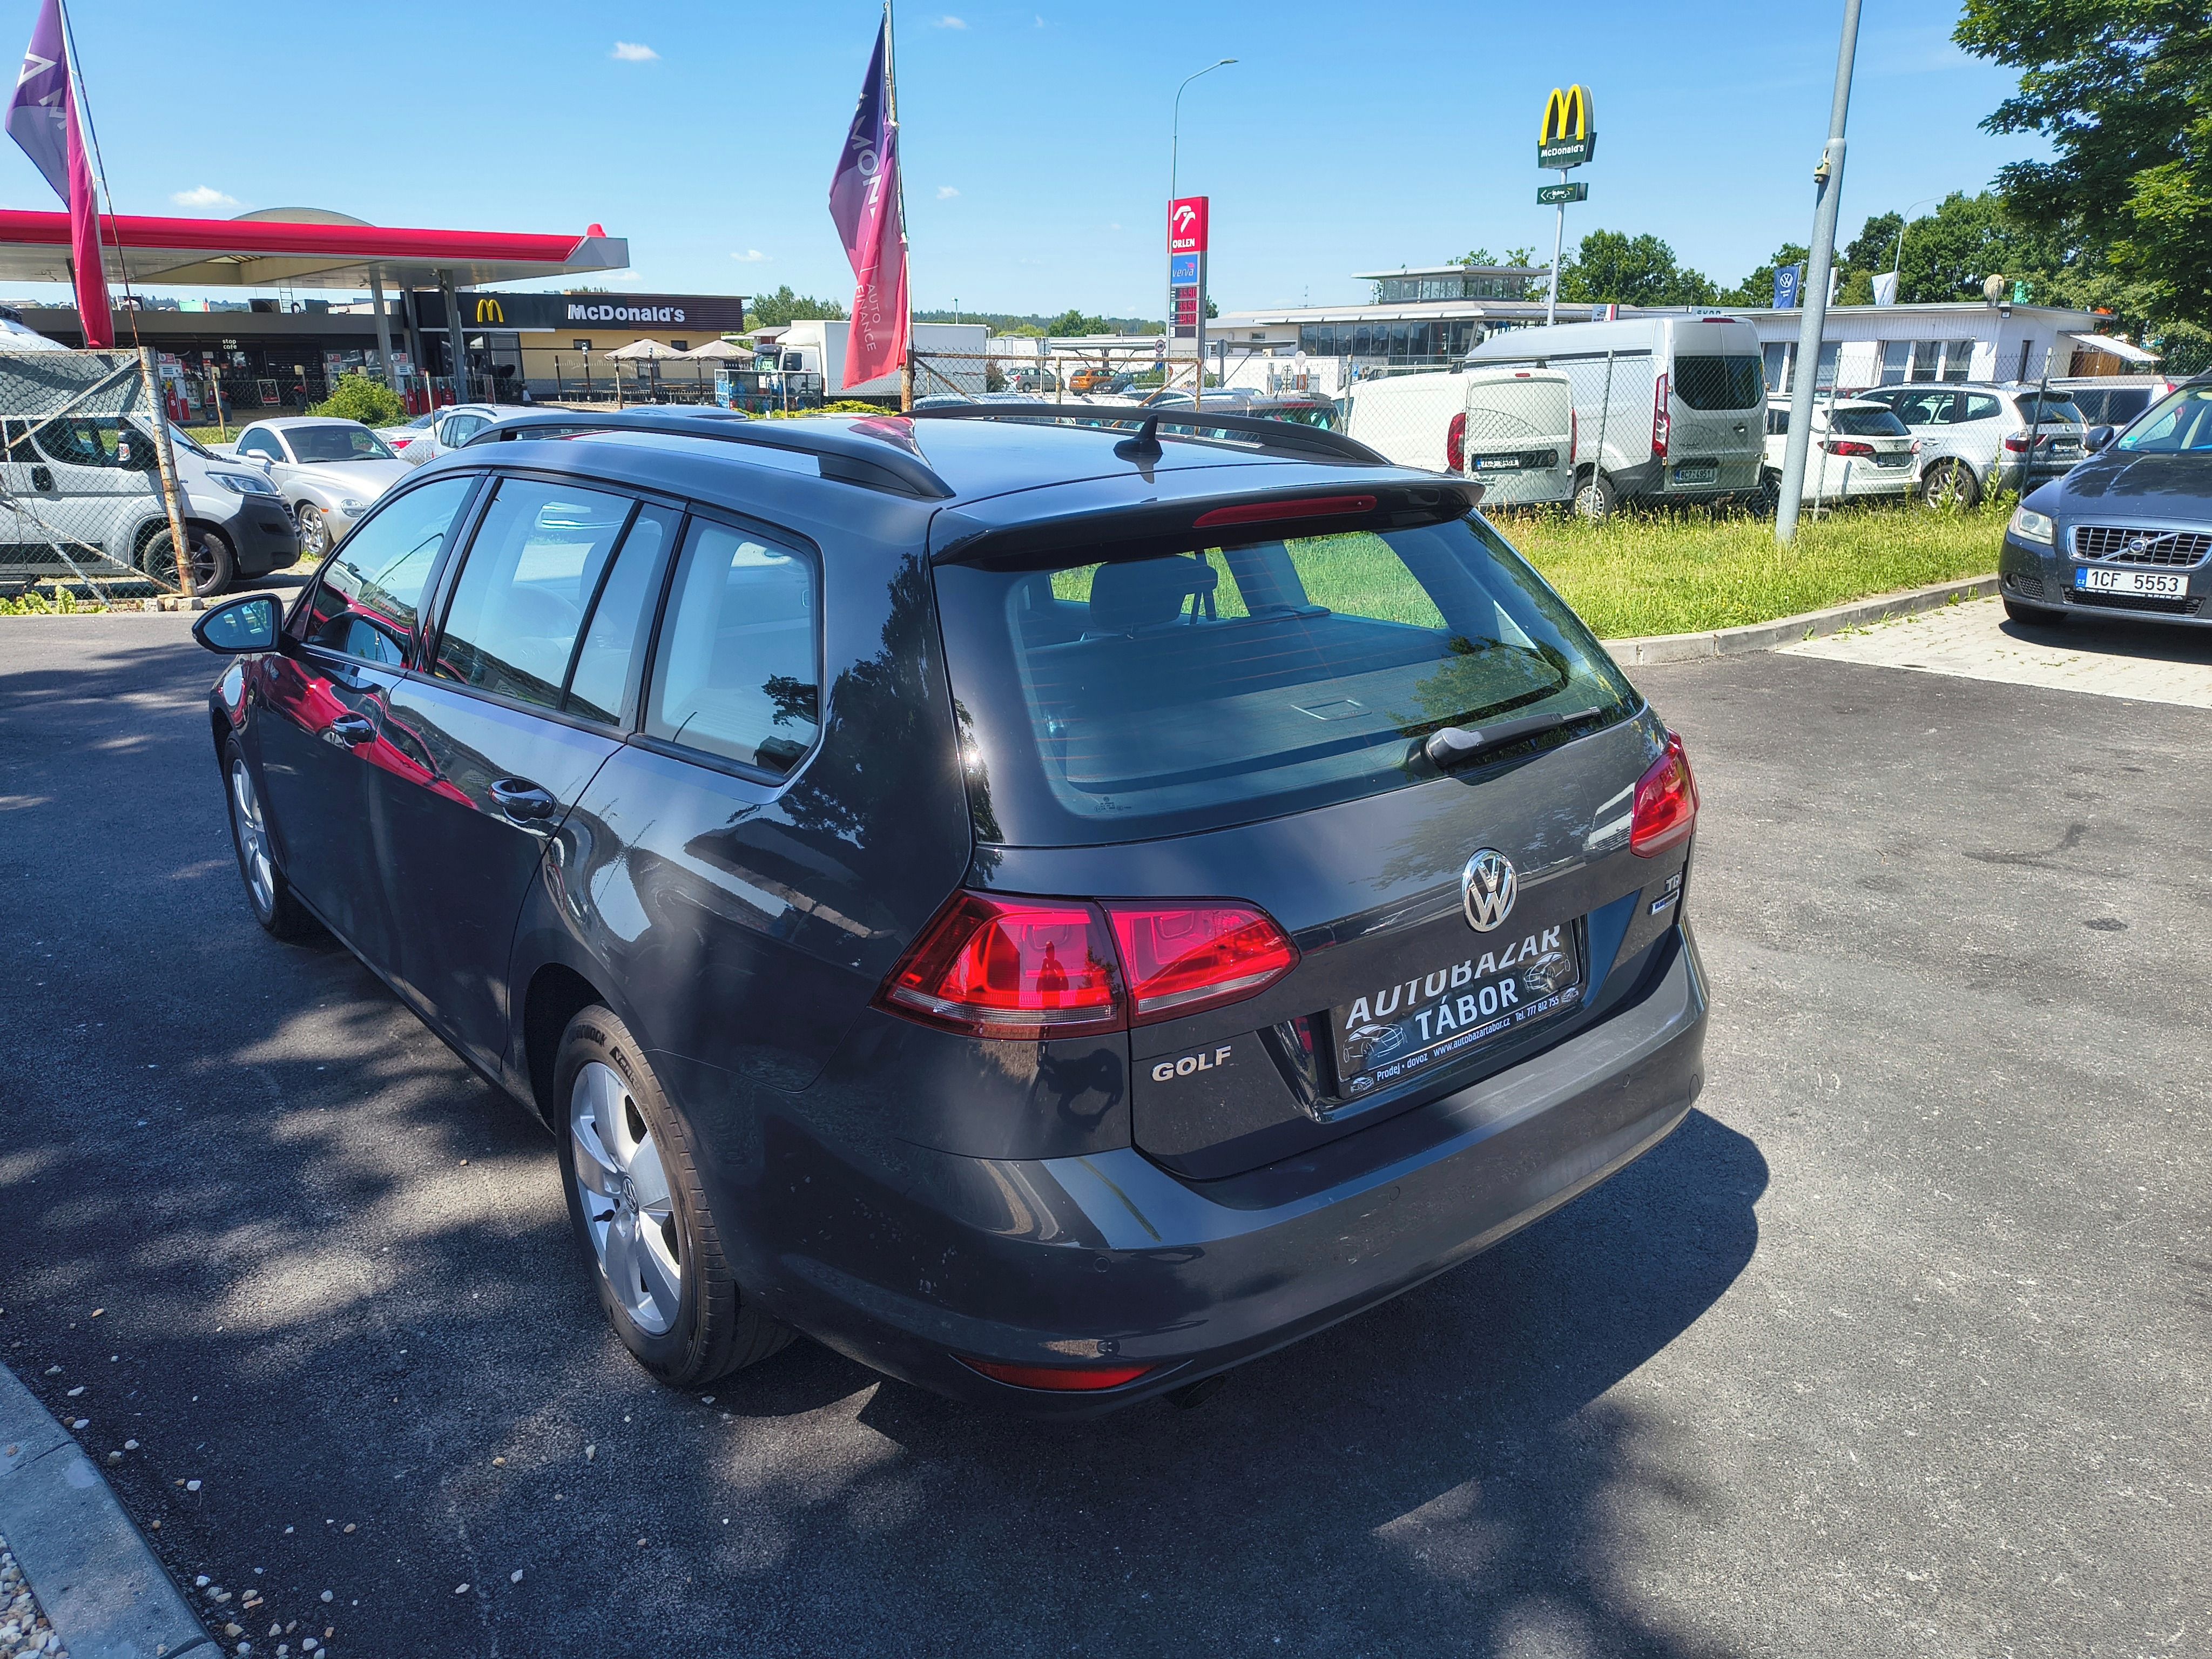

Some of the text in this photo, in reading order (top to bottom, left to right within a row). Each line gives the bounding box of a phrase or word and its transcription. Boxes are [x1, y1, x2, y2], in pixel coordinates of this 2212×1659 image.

[1541, 144, 1584, 158] McDonald's
[1172, 238, 1195, 248] ORLEN
[568, 304, 685, 322] McDonald's
[856, 284, 877, 352] FINANCE
[866, 283, 881, 323] AUTO
[2092, 570, 2179, 592] 1CF 5553
[1345, 925, 1560, 1029] AUTOBAZAR
[1415, 977, 1519, 1041] TÁBOR
[1377, 995, 1559, 1081] Prodej dovoz www.autobazartabor.cz Tel. 777 812 755
[1151, 1045, 1231, 1081] GOLF
